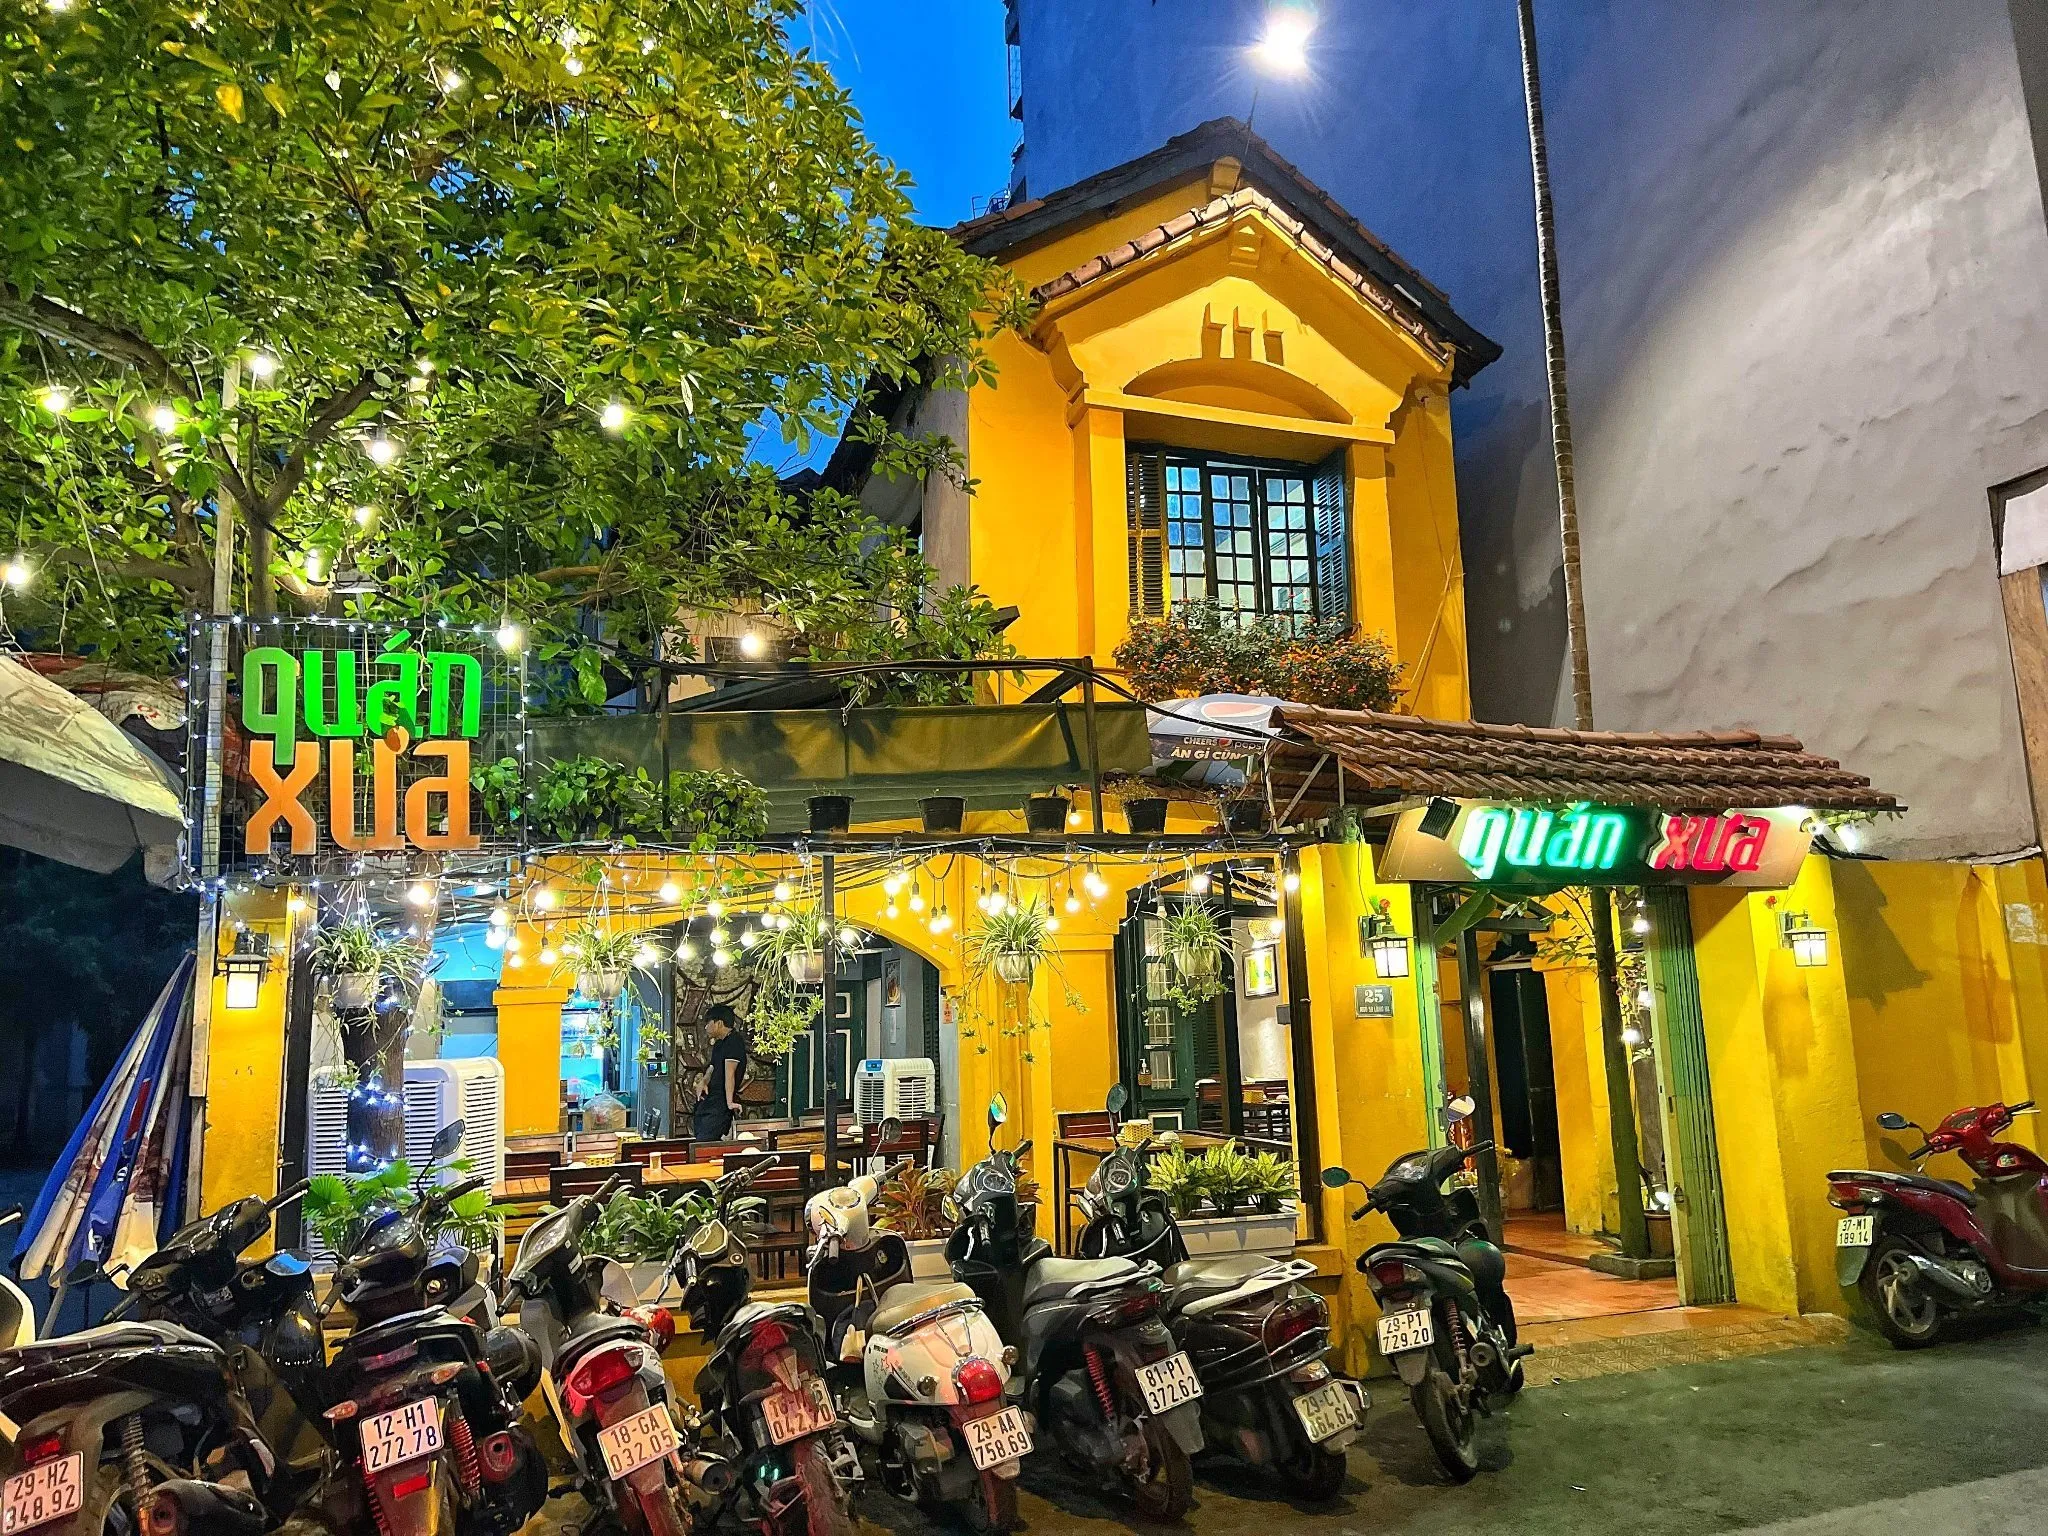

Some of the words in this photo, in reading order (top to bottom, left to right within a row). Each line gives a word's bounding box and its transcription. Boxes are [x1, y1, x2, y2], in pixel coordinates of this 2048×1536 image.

[242, 629, 482, 765] quán
[1183, 736, 1218, 747] CHEERS
[1458, 801, 1627, 880] quán
[1652, 812, 1771, 872] xưa
[1364, 989, 1384, 1003] 25
[1383, 1327, 1430, 1352] 729.20
[1385, 1312, 1422, 1334] 29-P1
[1145, 1357, 1185, 1388] 81-P1
[1148, 1376, 1200, 1410] 372.62
[1301, 1386, 1341, 1418] 29-C1
[373, 1403, 426, 1440] 12-H1
[610, 1411, 661, 1448] 18-GA
[972, 1412, 1017, 1444] 29-AA
[369, 1425, 437, 1469] 272.78
[610, 1428, 674, 1473] 032.05
[974, 1431, 1029, 1466] 758.69
[13, 1460, 69, 1502] 29-H2
